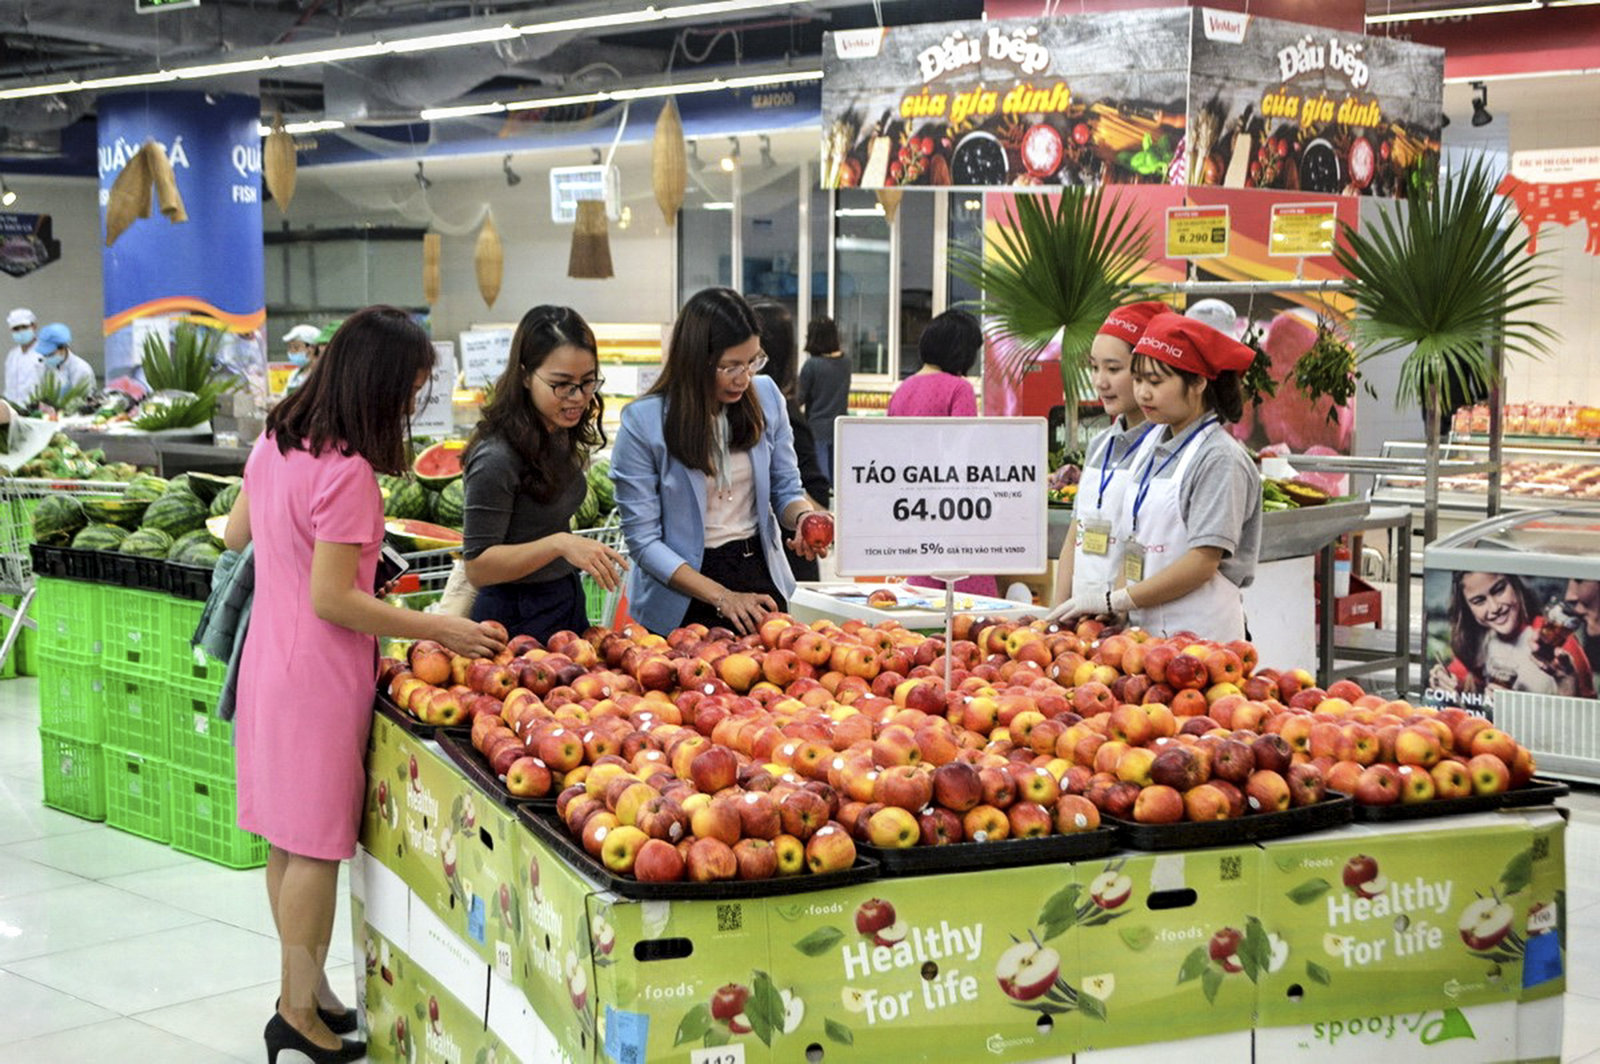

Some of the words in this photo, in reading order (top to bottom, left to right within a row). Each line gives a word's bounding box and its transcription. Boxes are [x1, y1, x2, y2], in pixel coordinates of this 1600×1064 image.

[1209, 16, 1240, 34] VinMart
[917, 30, 982, 83] Đầu
[988, 26, 1049, 74] bếp
[1278, 34, 1325, 82] Đầu
[1330, 38, 1368, 88] bếp
[901, 87, 947, 118] của
[951, 82, 997, 123] gia
[1002, 79, 1071, 113] đình
[1261, 87, 1299, 117] của
[1302, 91, 1335, 126] gia
[1337, 94, 1381, 128] đình
[232, 144, 262, 178] QU
[232, 185, 257, 203] FISH
[852, 460, 896, 484] TÁO
[903, 465, 959, 484] GALA
[966, 465, 1036, 483] BALAN
[892, 497, 992, 521] 64.000
[920, 543, 944, 555] 5%
[407, 780, 439, 828] Healthy
[527, 887, 562, 948] Healthy
[1327, 877, 1453, 927] Healthy
[842, 920, 983, 980] Healthy
[1340, 936, 1387, 968] for
[1395, 919, 1442, 957] life
[863, 989, 913, 1025] for
[921, 969, 978, 1010] life
